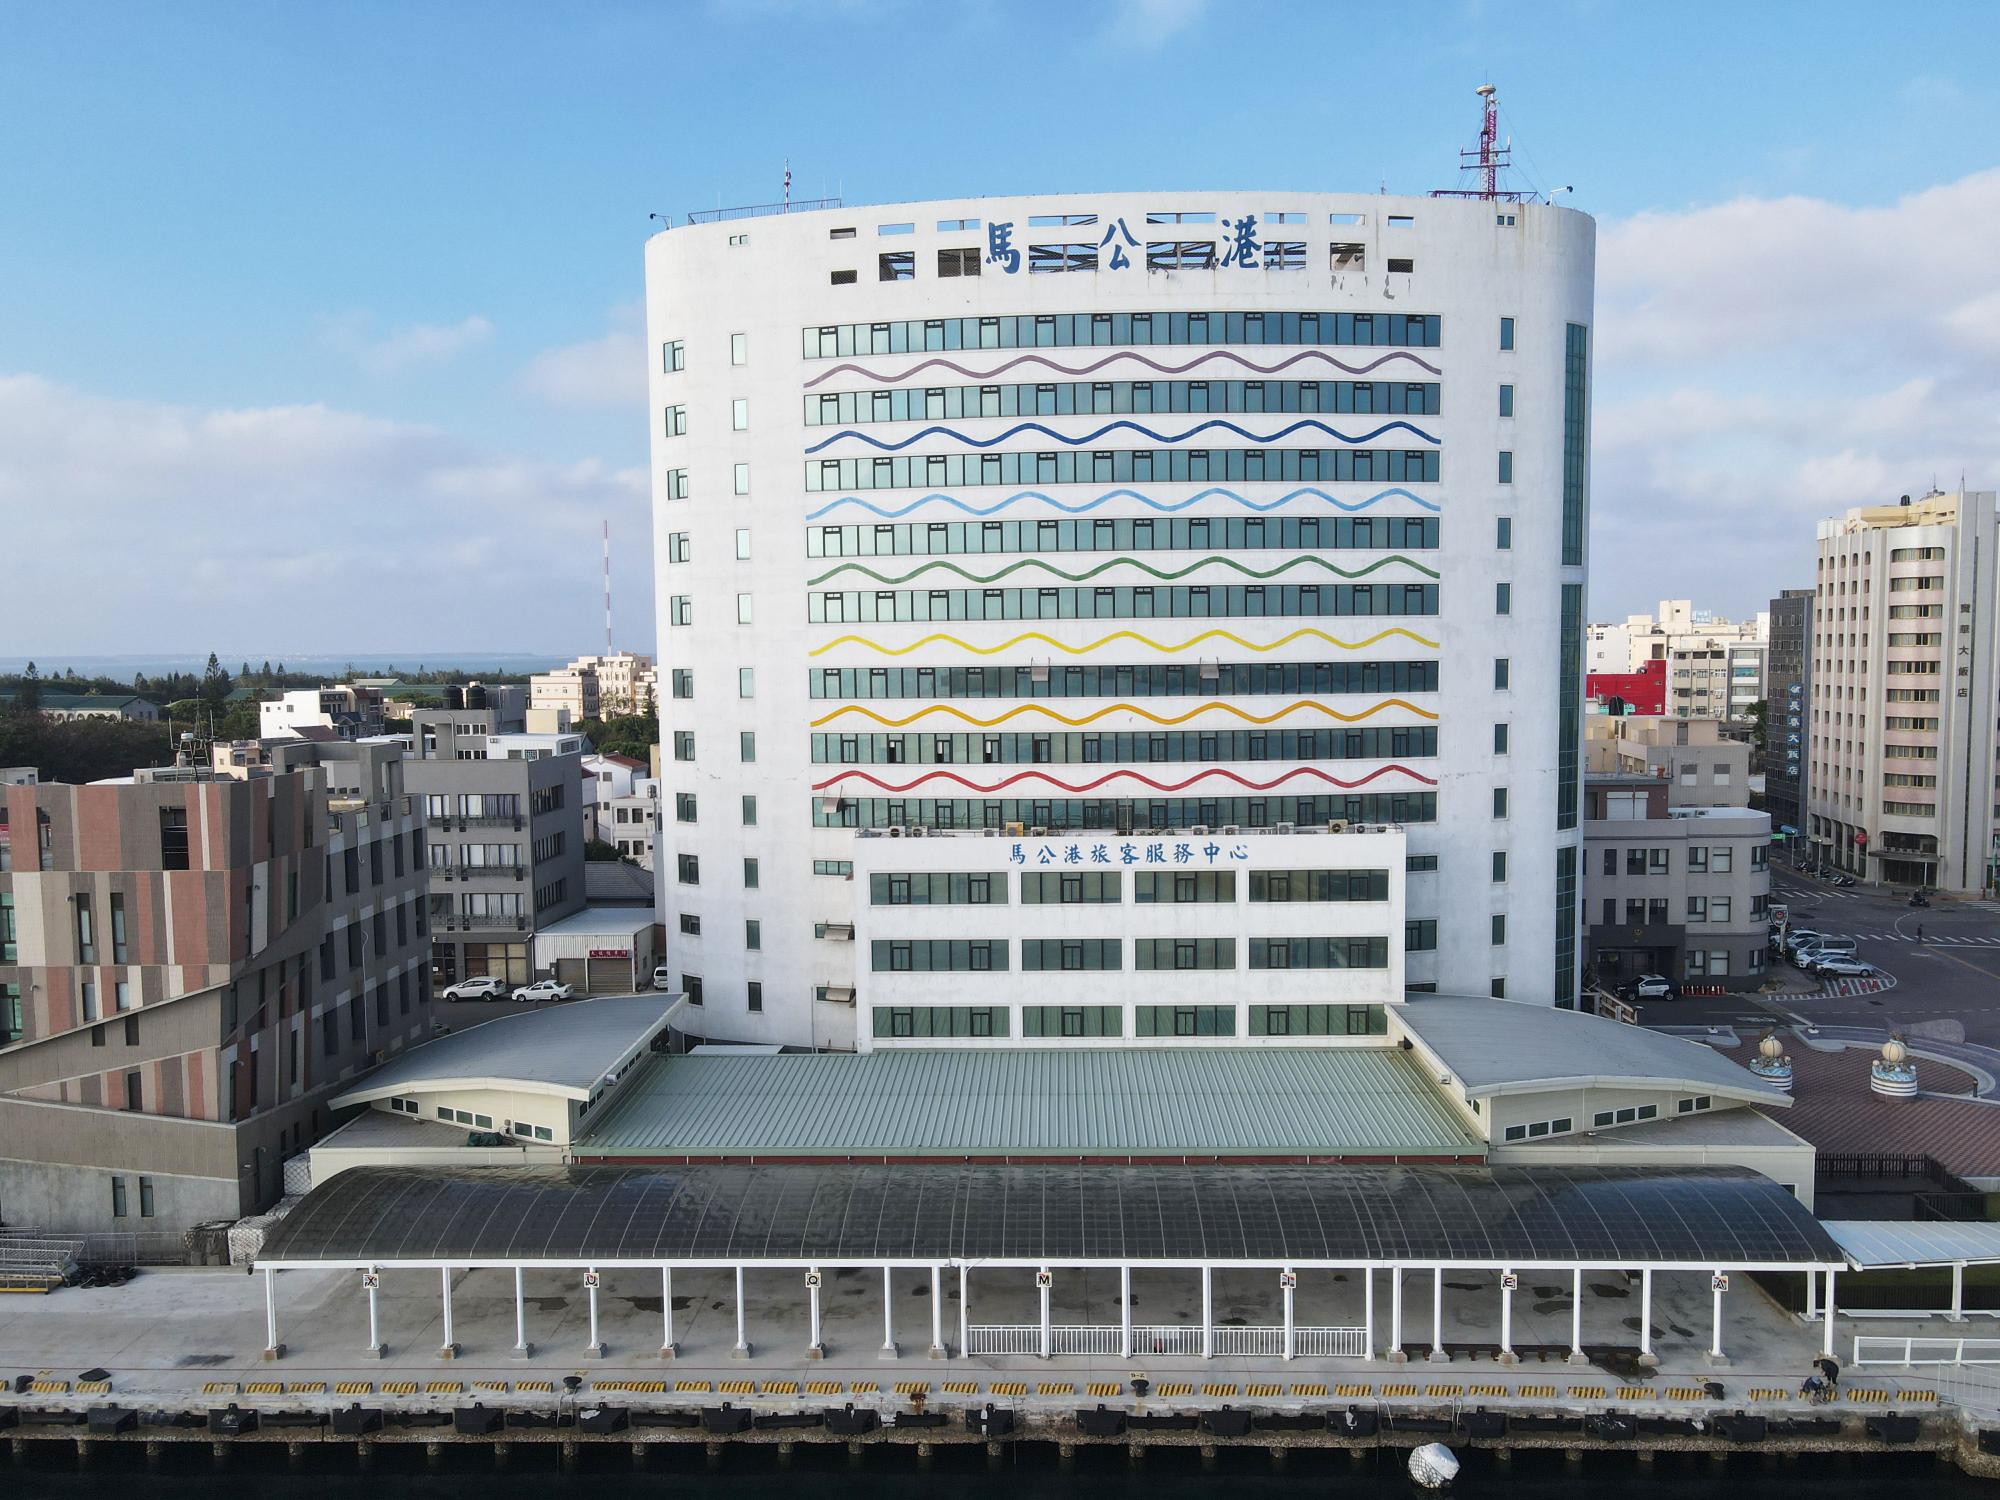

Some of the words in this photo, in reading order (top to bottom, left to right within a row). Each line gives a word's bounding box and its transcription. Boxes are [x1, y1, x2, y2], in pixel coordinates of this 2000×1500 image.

[986, 214, 1262, 274] 馬公港
[1009, 841, 1249, 865] 馬公港旅客服務中心
[367, 1276, 375, 1286] X
[587, 1275, 596, 1285] U
[808, 1275, 818, 1285] Q
[1039, 1275, 1050, 1285] M
[1504, 1277, 1514, 1287] E
[1716, 1279, 1725, 1290] A
